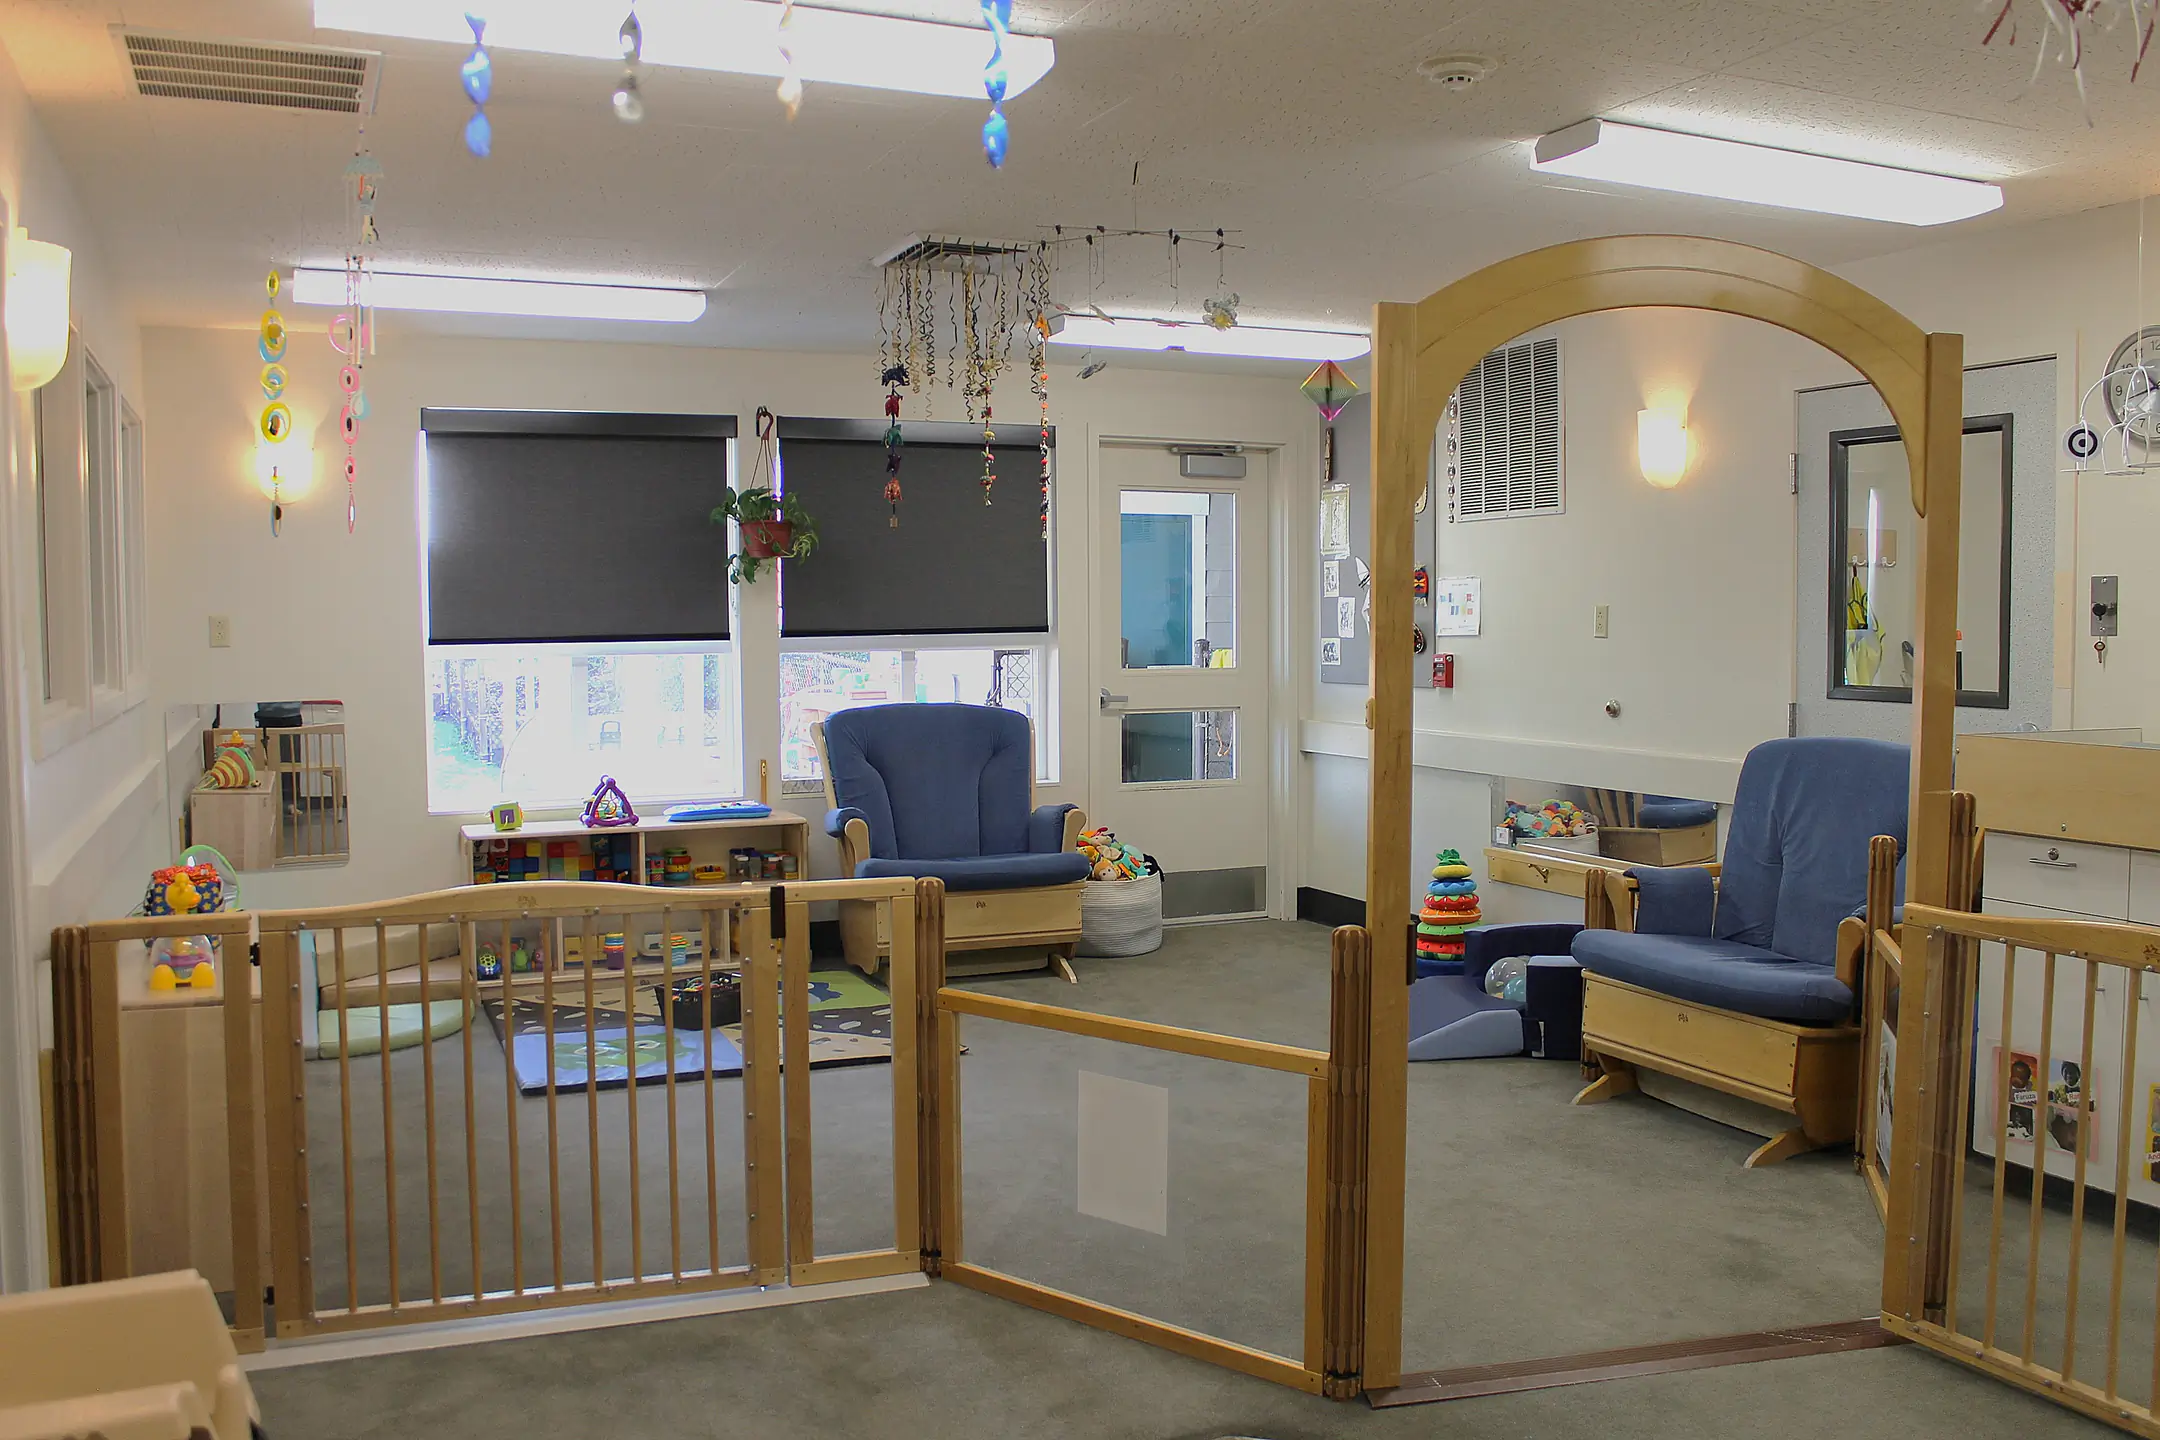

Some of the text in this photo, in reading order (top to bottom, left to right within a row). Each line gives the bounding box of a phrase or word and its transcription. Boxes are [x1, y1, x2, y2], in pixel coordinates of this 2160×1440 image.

[2133, 348, 2143, 359] 11
[2121, 363, 2133, 375] 10
[2115, 385, 2123, 396] 9
[2138, 418, 2146, 428] 7
